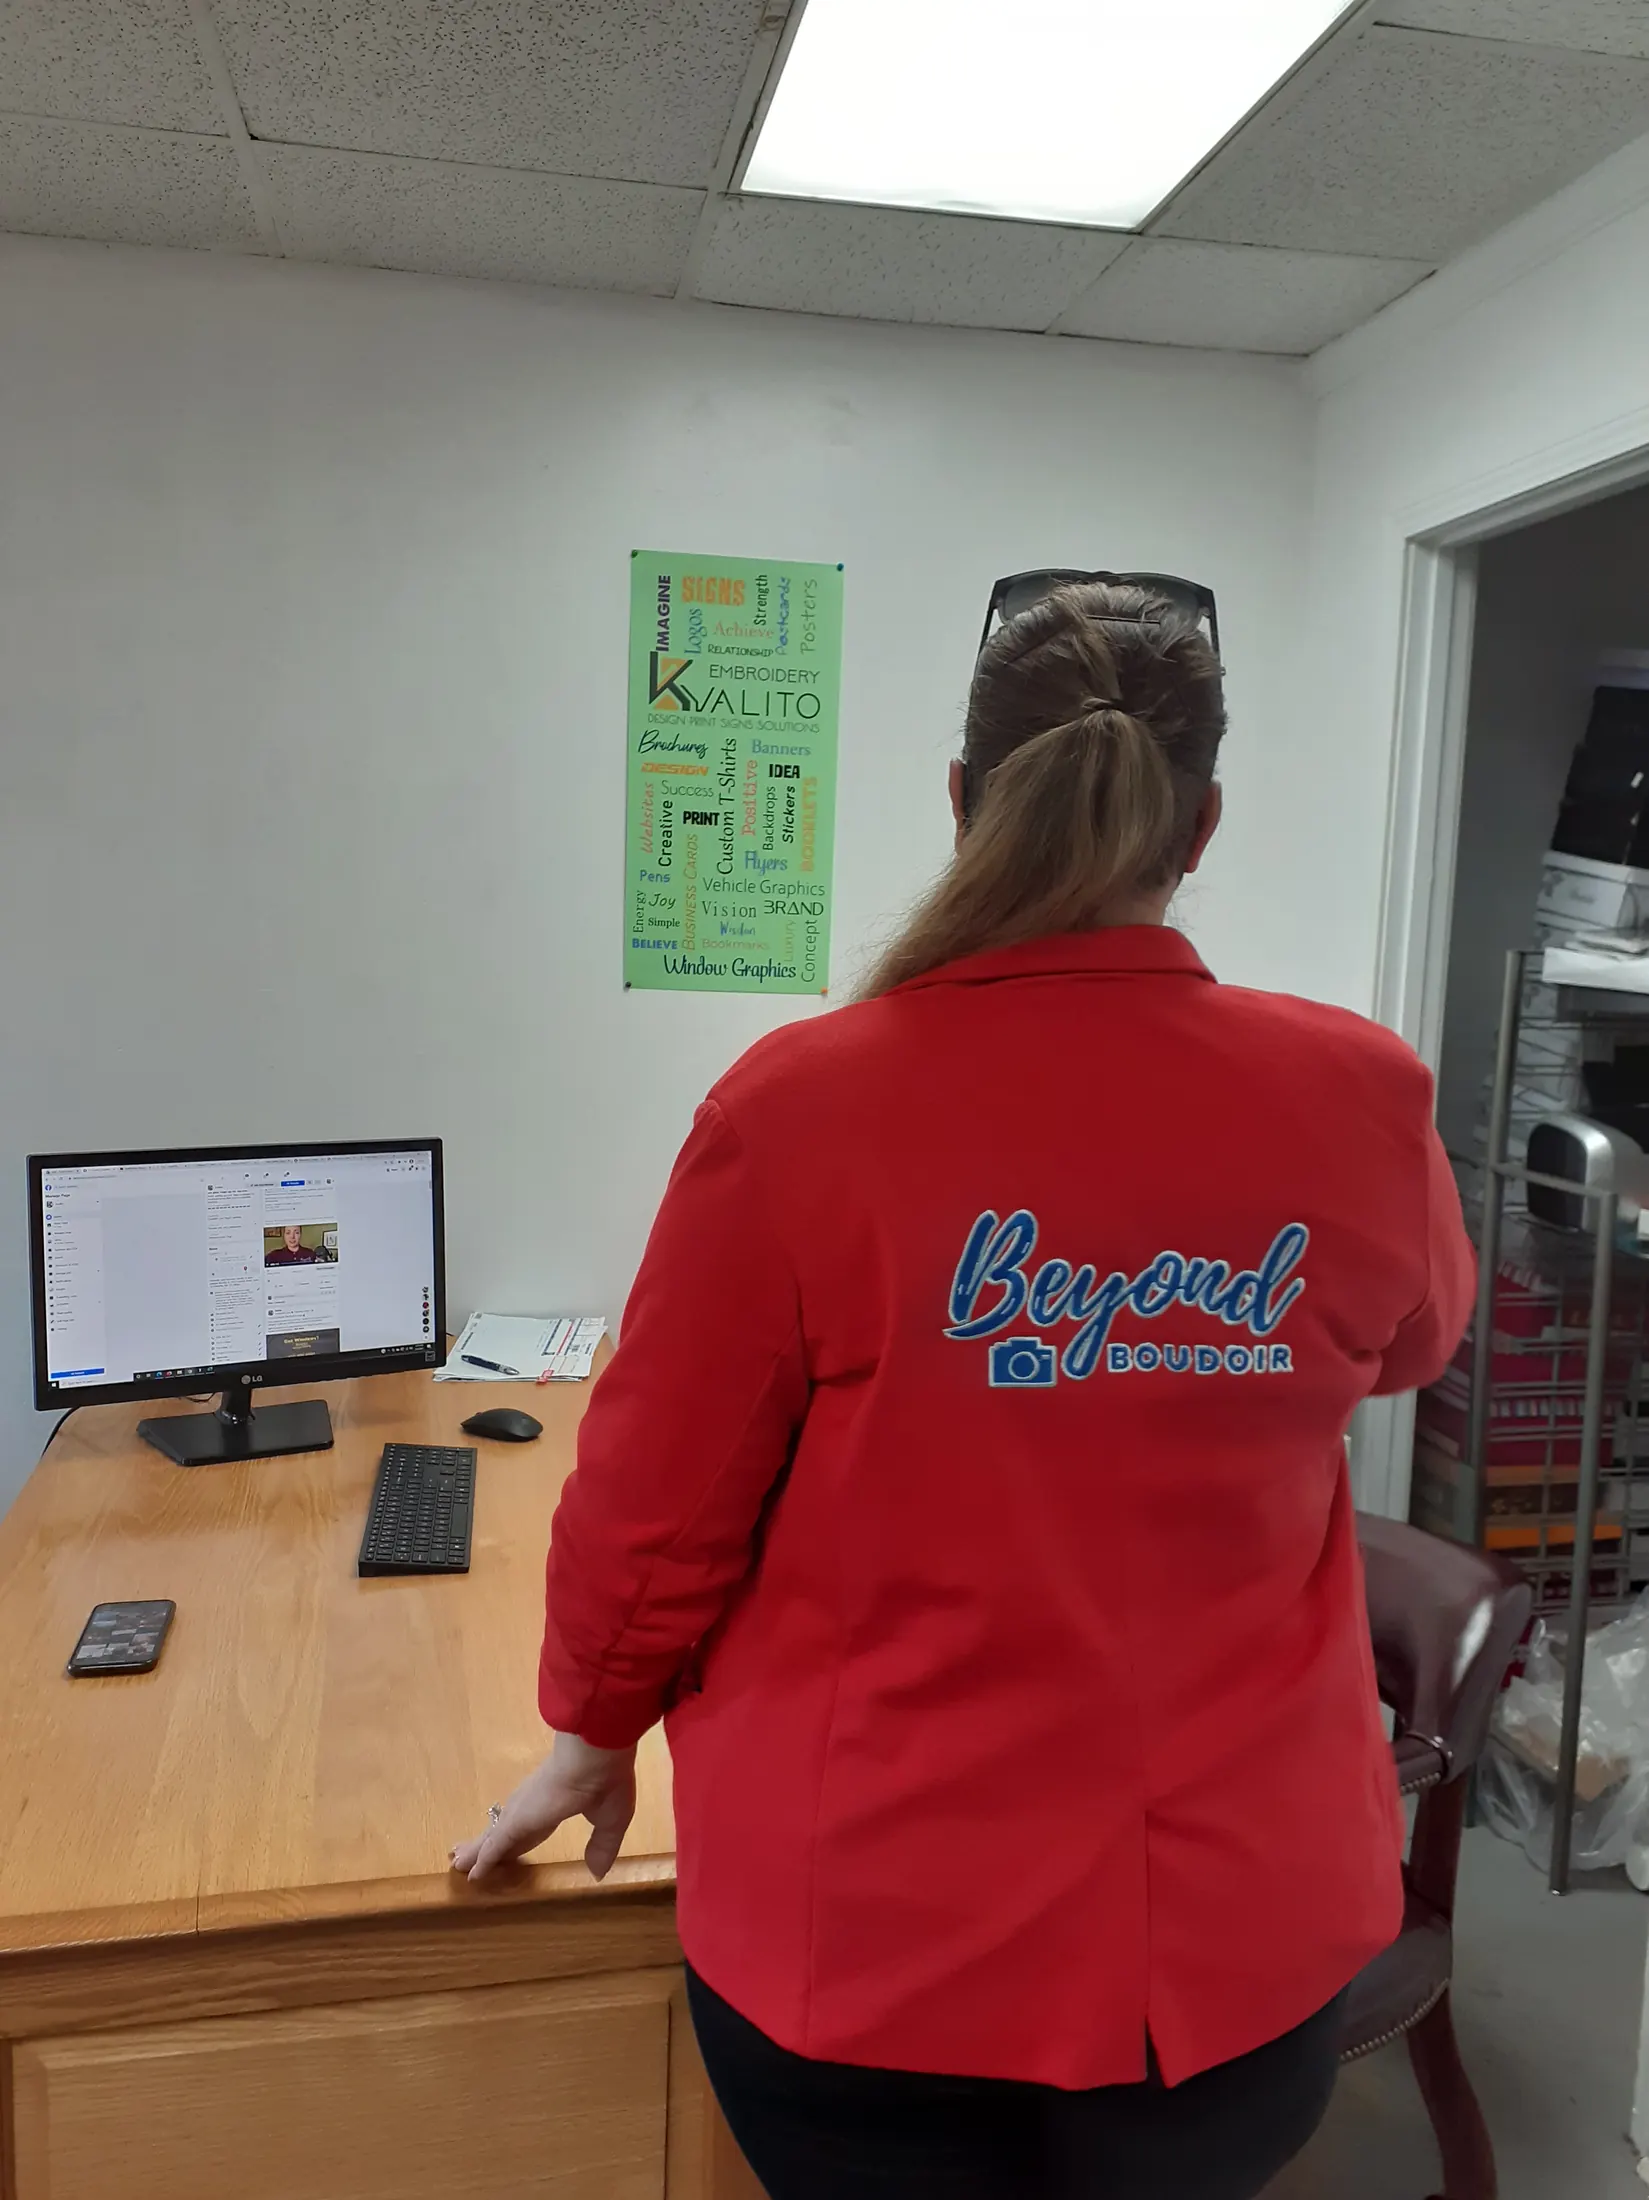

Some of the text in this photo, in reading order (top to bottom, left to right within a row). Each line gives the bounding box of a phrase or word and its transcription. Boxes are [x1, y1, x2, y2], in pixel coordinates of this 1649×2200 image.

[682, 576, 745, 606] SIGNS
[754, 574, 769, 626] Strength
[656, 575, 671, 652] IMAGINE
[800, 578, 818, 655] Posters
[684, 608, 707, 654] Logos
[712, 620, 774, 639] Achieve
[708, 643, 773, 657] RELATIONSHIP
[709, 664, 820, 683] EMBROIDERY
[648, 713, 820, 734] DESIGN PRINT SIGNS SOLUTIONS
[752, 738, 811, 756] Banners
[641, 762, 709, 777] DESIGN
[769, 764, 800, 779] IDEA
[661, 780, 714, 798] Success
[741, 760, 758, 836] Positive
[638, 782, 654, 854] Websites
[683, 811, 719, 826] PRINT
[717, 738, 737, 875] Custom T-Shirts
[763, 786, 778, 850] Backdrops
[782, 785, 796, 843] Stickers
[658, 800, 673, 867] Creative
[744, 850, 788, 876] Flyers
[639, 869, 670, 884] Pens
[702, 877, 826, 898] Vehicle Graphics
[648, 893, 676, 910] Joy
[682, 833, 698, 952] BUSINESS CARDS
[633, 890, 647, 933] Energy
[702, 901, 757, 918] Vision
[764, 900, 824, 916] BRAND
[648, 918, 680, 929] Simple
[632, 938, 678, 950] BELIEVE
[702, 938, 771, 951] Bookmarks
[801, 919, 821, 983] Concept
[663, 954, 797, 983] Window Graphics
[943, 1209, 1310, 1379] Beyond
[1107, 1342, 1294, 1375] BOUDOIR
